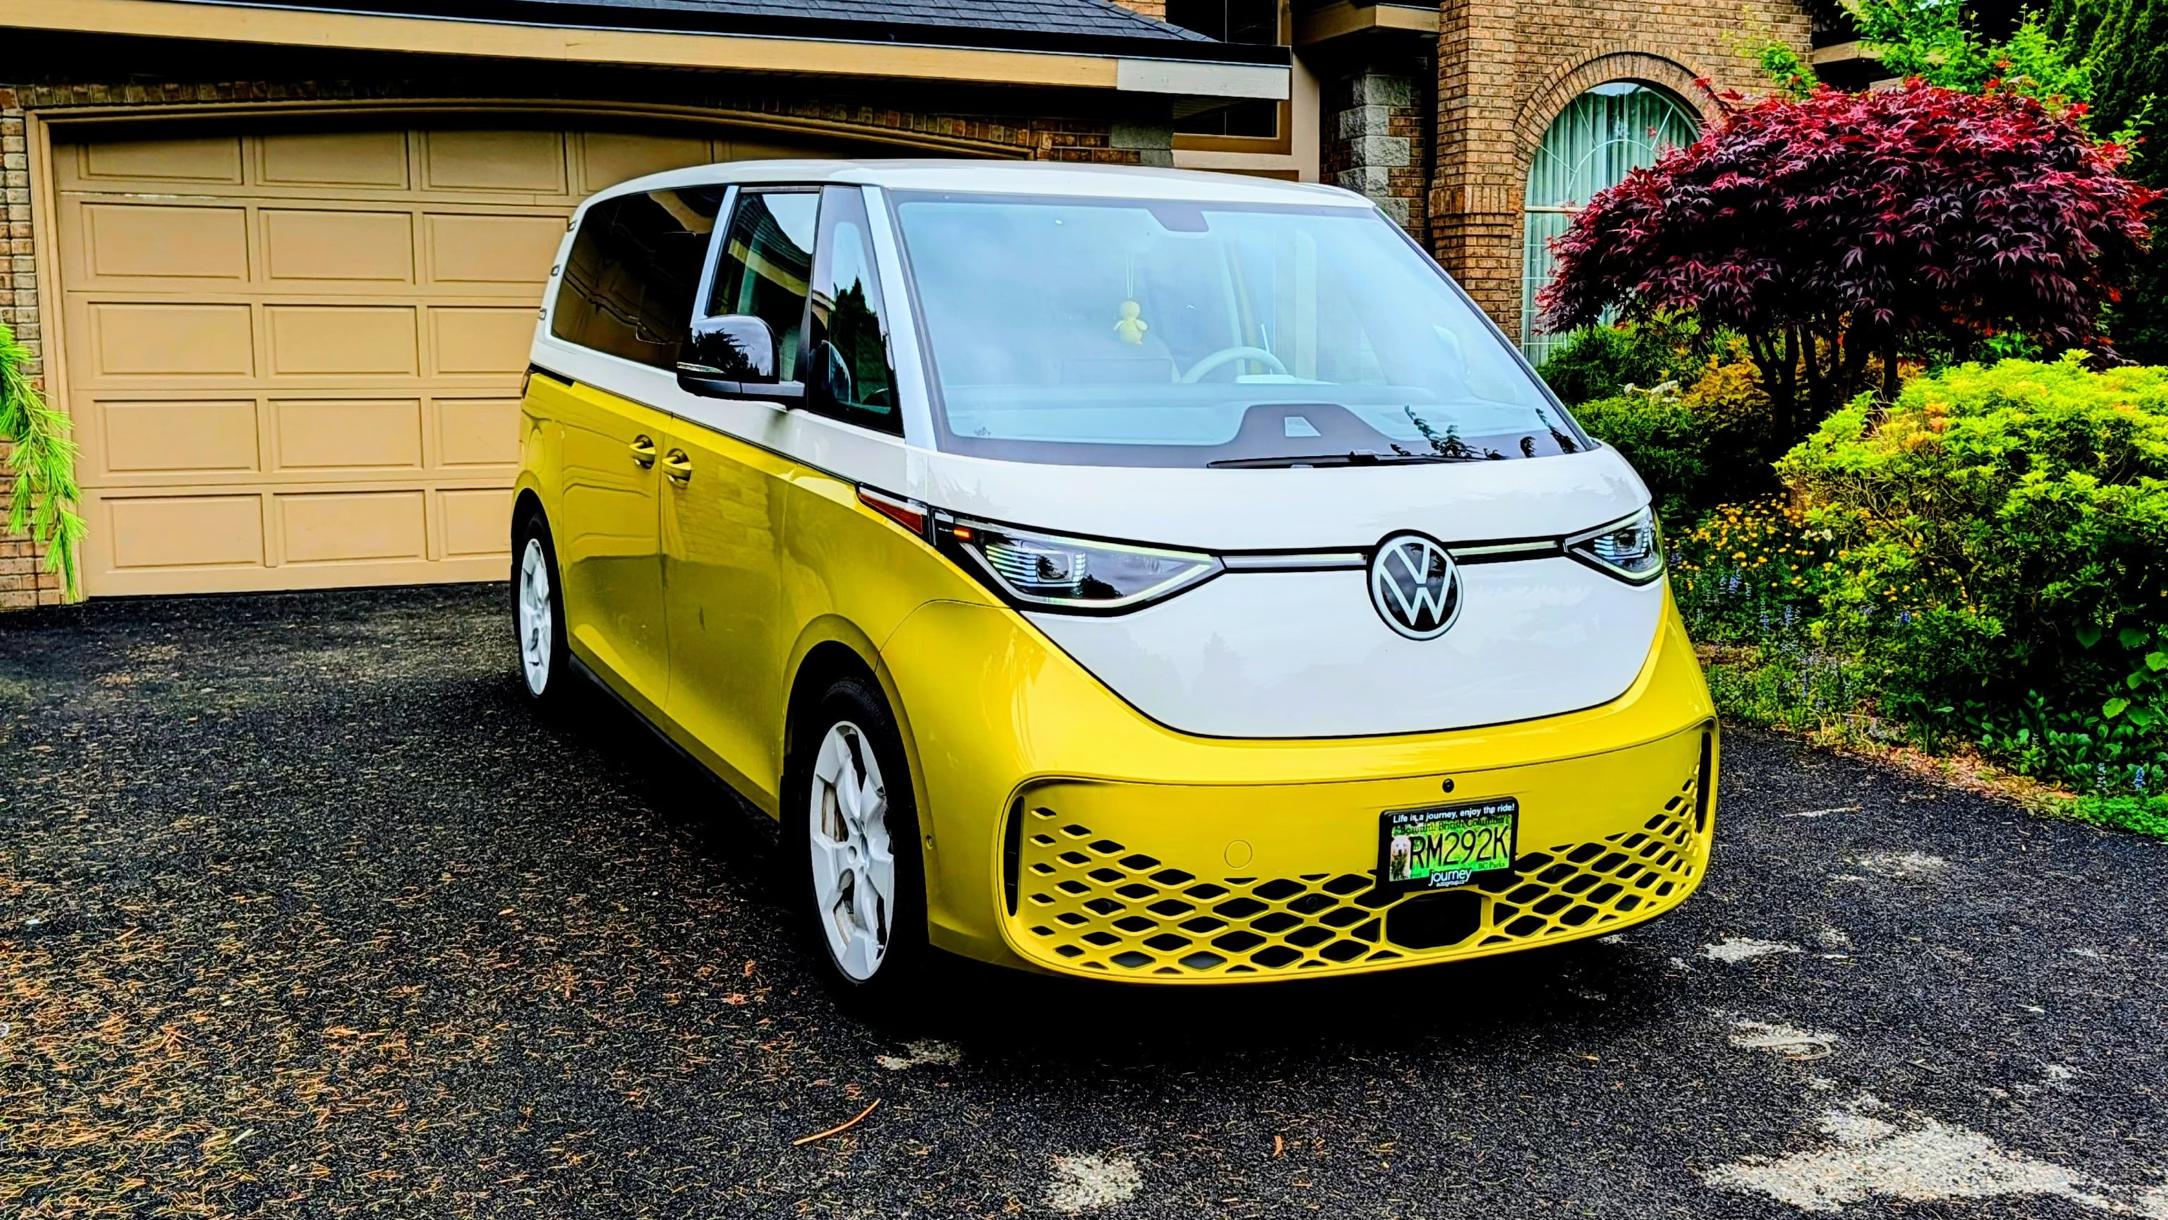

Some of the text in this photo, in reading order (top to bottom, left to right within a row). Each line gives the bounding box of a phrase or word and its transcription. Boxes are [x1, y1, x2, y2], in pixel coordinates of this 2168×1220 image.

[1376, 540, 1456, 628] VW
[1393, 814, 1408, 823] Life
[1410, 813, 1417, 821] is
[1460, 808, 1481, 818] enjoy
[1484, 806, 1496, 814] the
[1498, 803, 1515, 812] ride!
[1410, 825, 1508, 869] RM292K
[1428, 869, 1472, 887] journey
